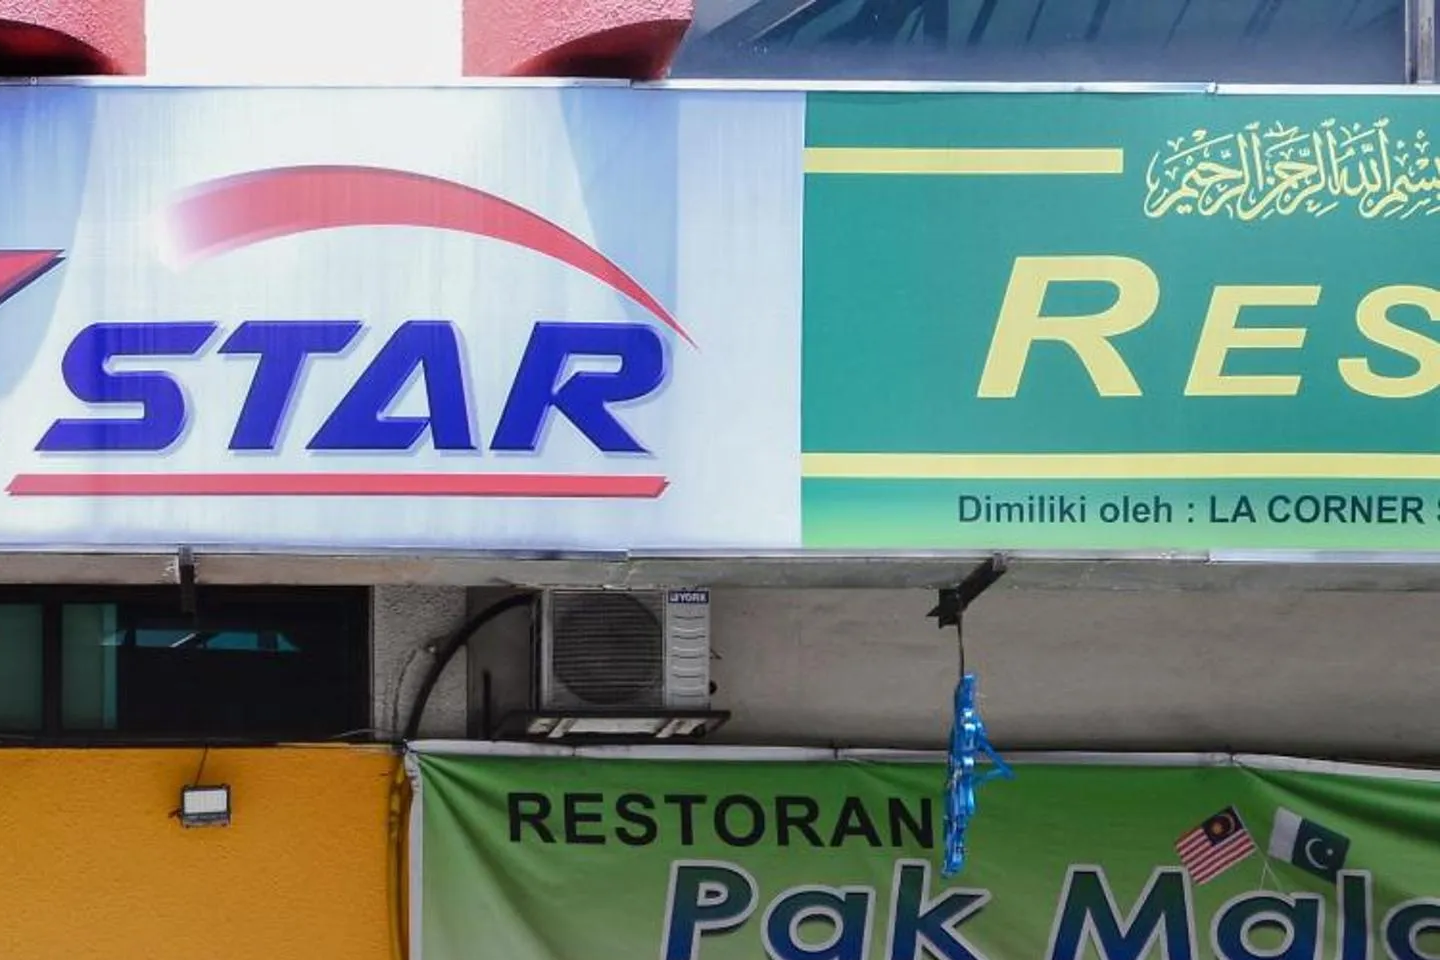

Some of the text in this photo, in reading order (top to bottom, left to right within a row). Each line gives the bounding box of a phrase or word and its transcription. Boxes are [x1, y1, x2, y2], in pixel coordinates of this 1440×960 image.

[34, 319, 672, 456] STAR
[958, 495, 1087, 523] Dimiliki
[1099, 495, 1173, 524] oleh
[1209, 495, 1257, 523] LA
[1267, 494, 1425, 524] CORNER
[507, 791, 934, 849] RESTORAN
